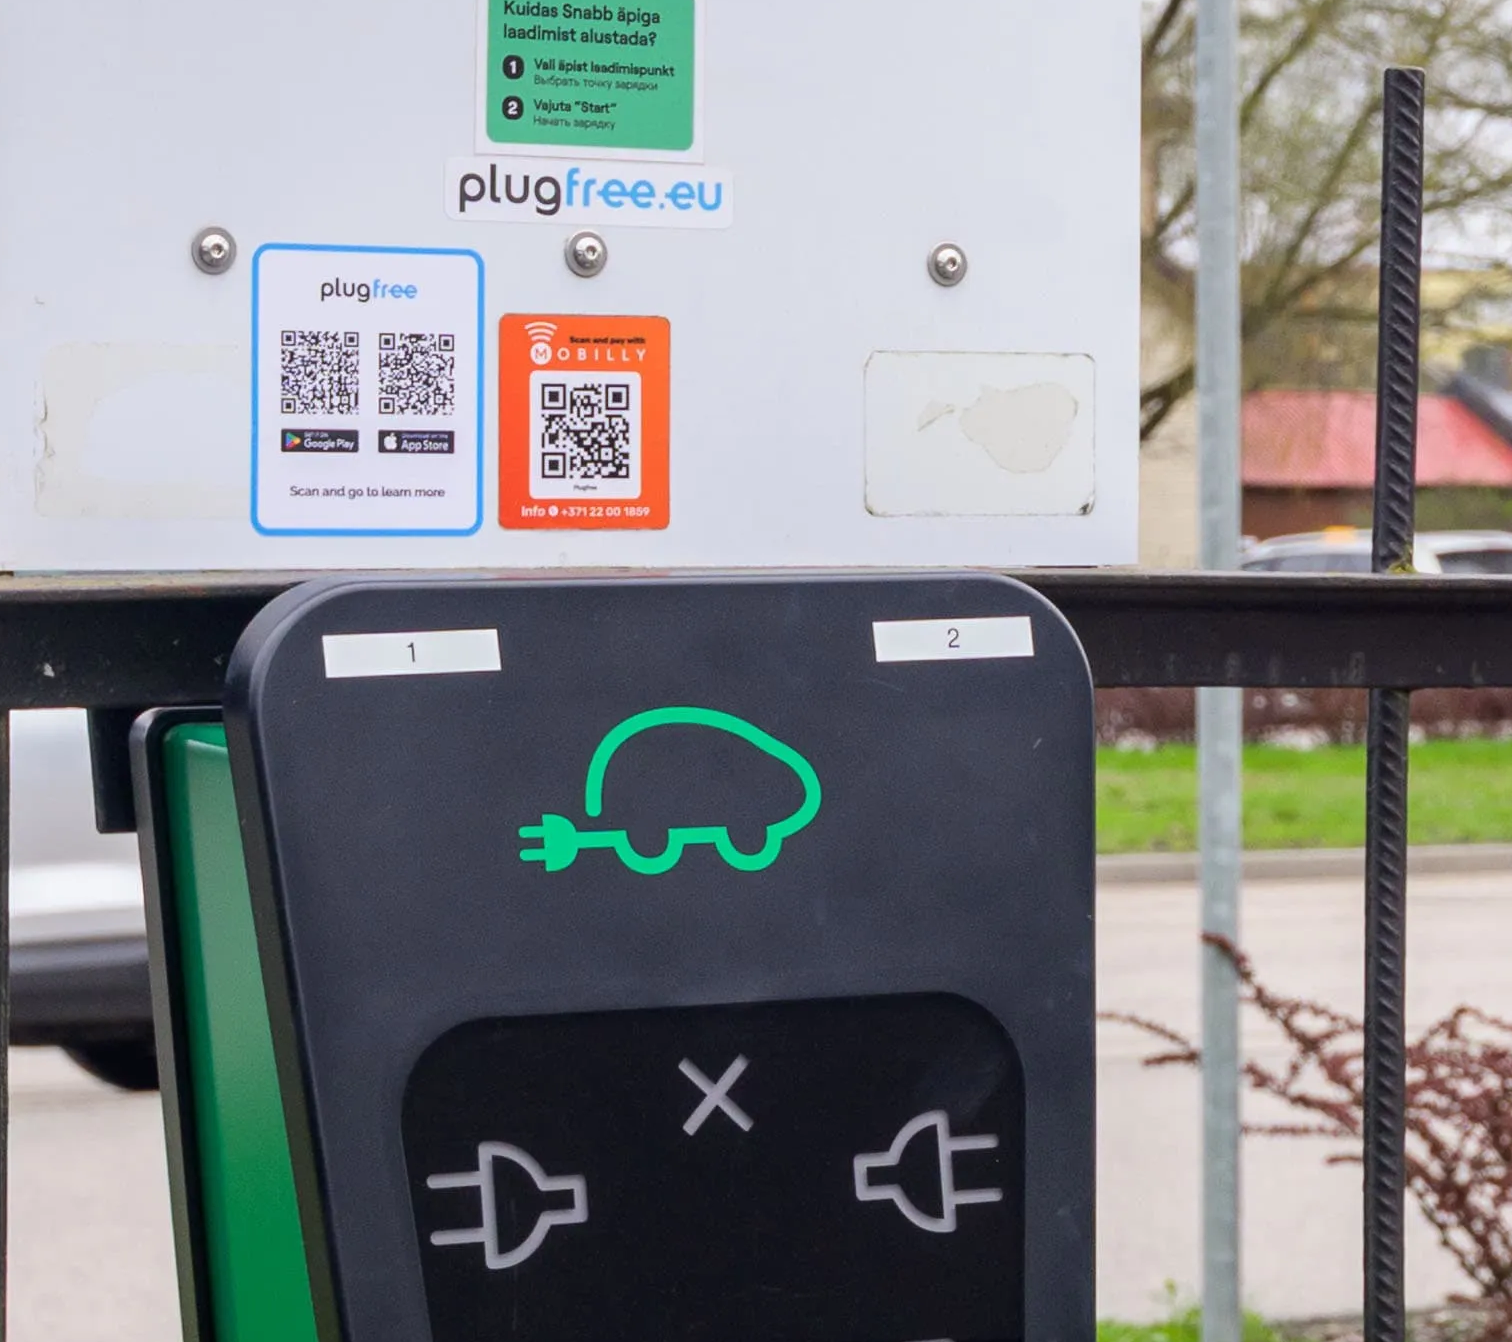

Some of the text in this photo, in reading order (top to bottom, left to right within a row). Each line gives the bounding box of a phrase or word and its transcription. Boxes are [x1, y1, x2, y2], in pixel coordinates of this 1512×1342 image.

[503, 0, 661, 27] Kuidas Snabb äpiga
[503, 23, 657, 47] laadimist alustada?
[509, 60, 517, 75] 1
[558, 60, 588, 74] äpist
[590, 60, 675, 78] laadimispunkt
[508, 100, 518, 115] 2
[533, 98, 571, 114] Vajuta
[458, 163, 722, 216] plugfree.eu
[320, 277, 418, 302] plugfree
[569, 335, 646, 347] Scan and pay with
[304, 438, 355, 451] Google Play
[401, 439, 449, 451] App Store
[290, 485, 446, 500] Scan and go to learn more
[521, 505, 651, 517] Info +371 22 00 1859
[946, 627, 961, 651] 2
[406, 642, 418, 664] 1
